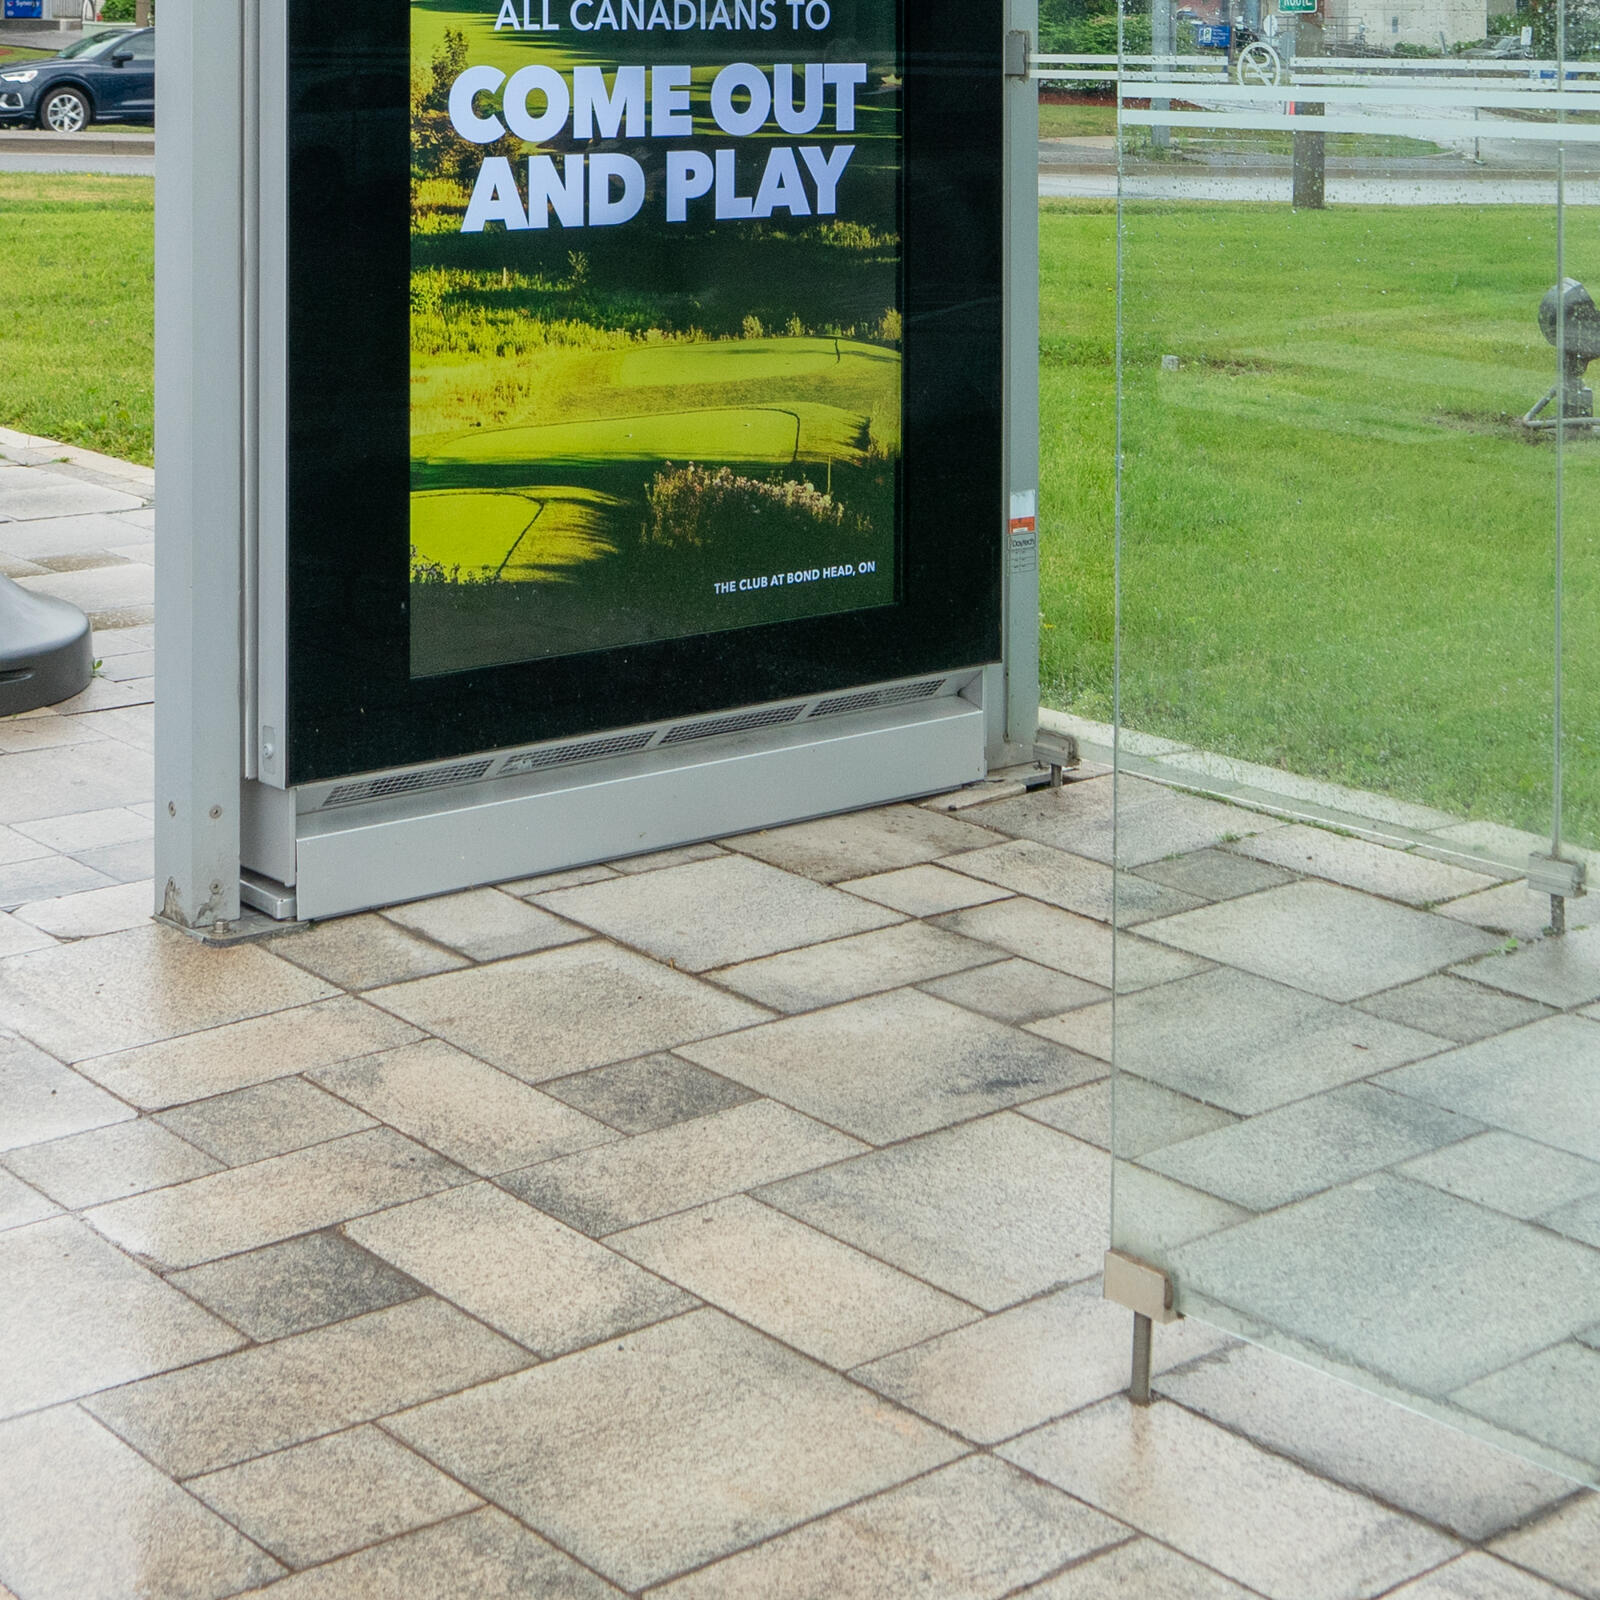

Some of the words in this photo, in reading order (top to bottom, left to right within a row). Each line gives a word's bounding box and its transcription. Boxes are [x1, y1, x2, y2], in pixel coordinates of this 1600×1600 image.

[448, 64, 692, 144] COME
[710, 62, 867, 137] OUT
[460, 153, 646, 233] AND
[666, 144, 856, 223] PLAY
[714, 581, 737, 595] THE
[739, 576, 768, 591] CLUB
[770, 573, 785, 587] AT
[786, 568, 821, 584] BOND
[822, 564, 856, 579] HEAD,
[858, 560, 877, 574] ON
